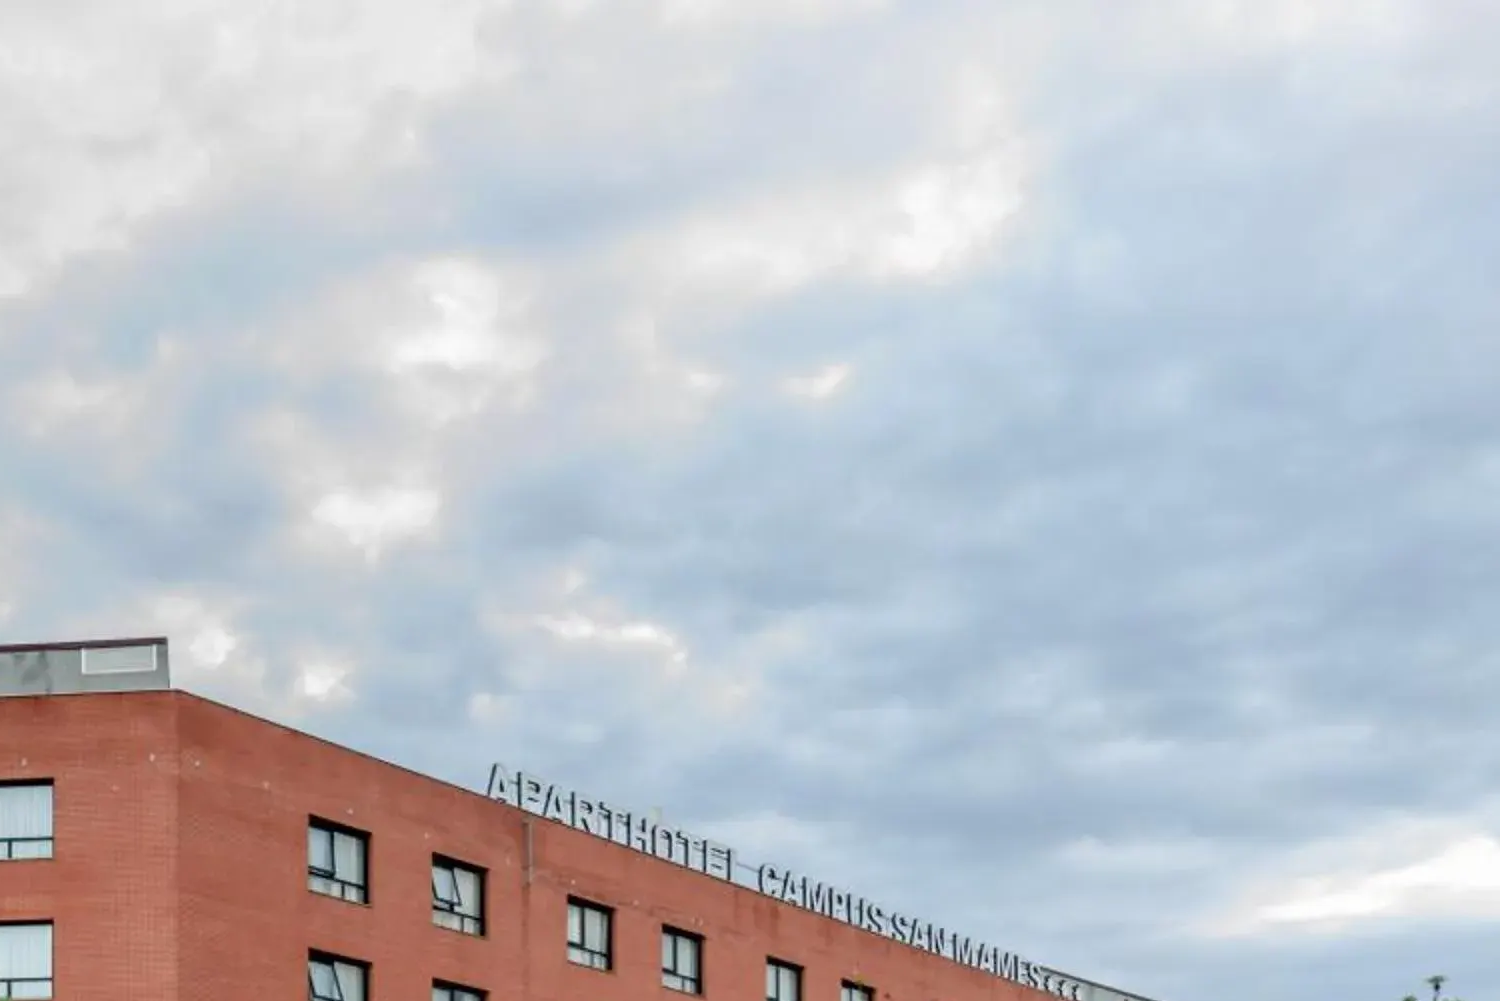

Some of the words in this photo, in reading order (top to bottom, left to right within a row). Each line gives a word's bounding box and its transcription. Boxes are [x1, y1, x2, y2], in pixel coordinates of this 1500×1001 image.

[486, 763, 738, 881] APARTHOTEL
[758, 863, 886, 935] CAMPUS
[891, 911, 946, 955] SAN
